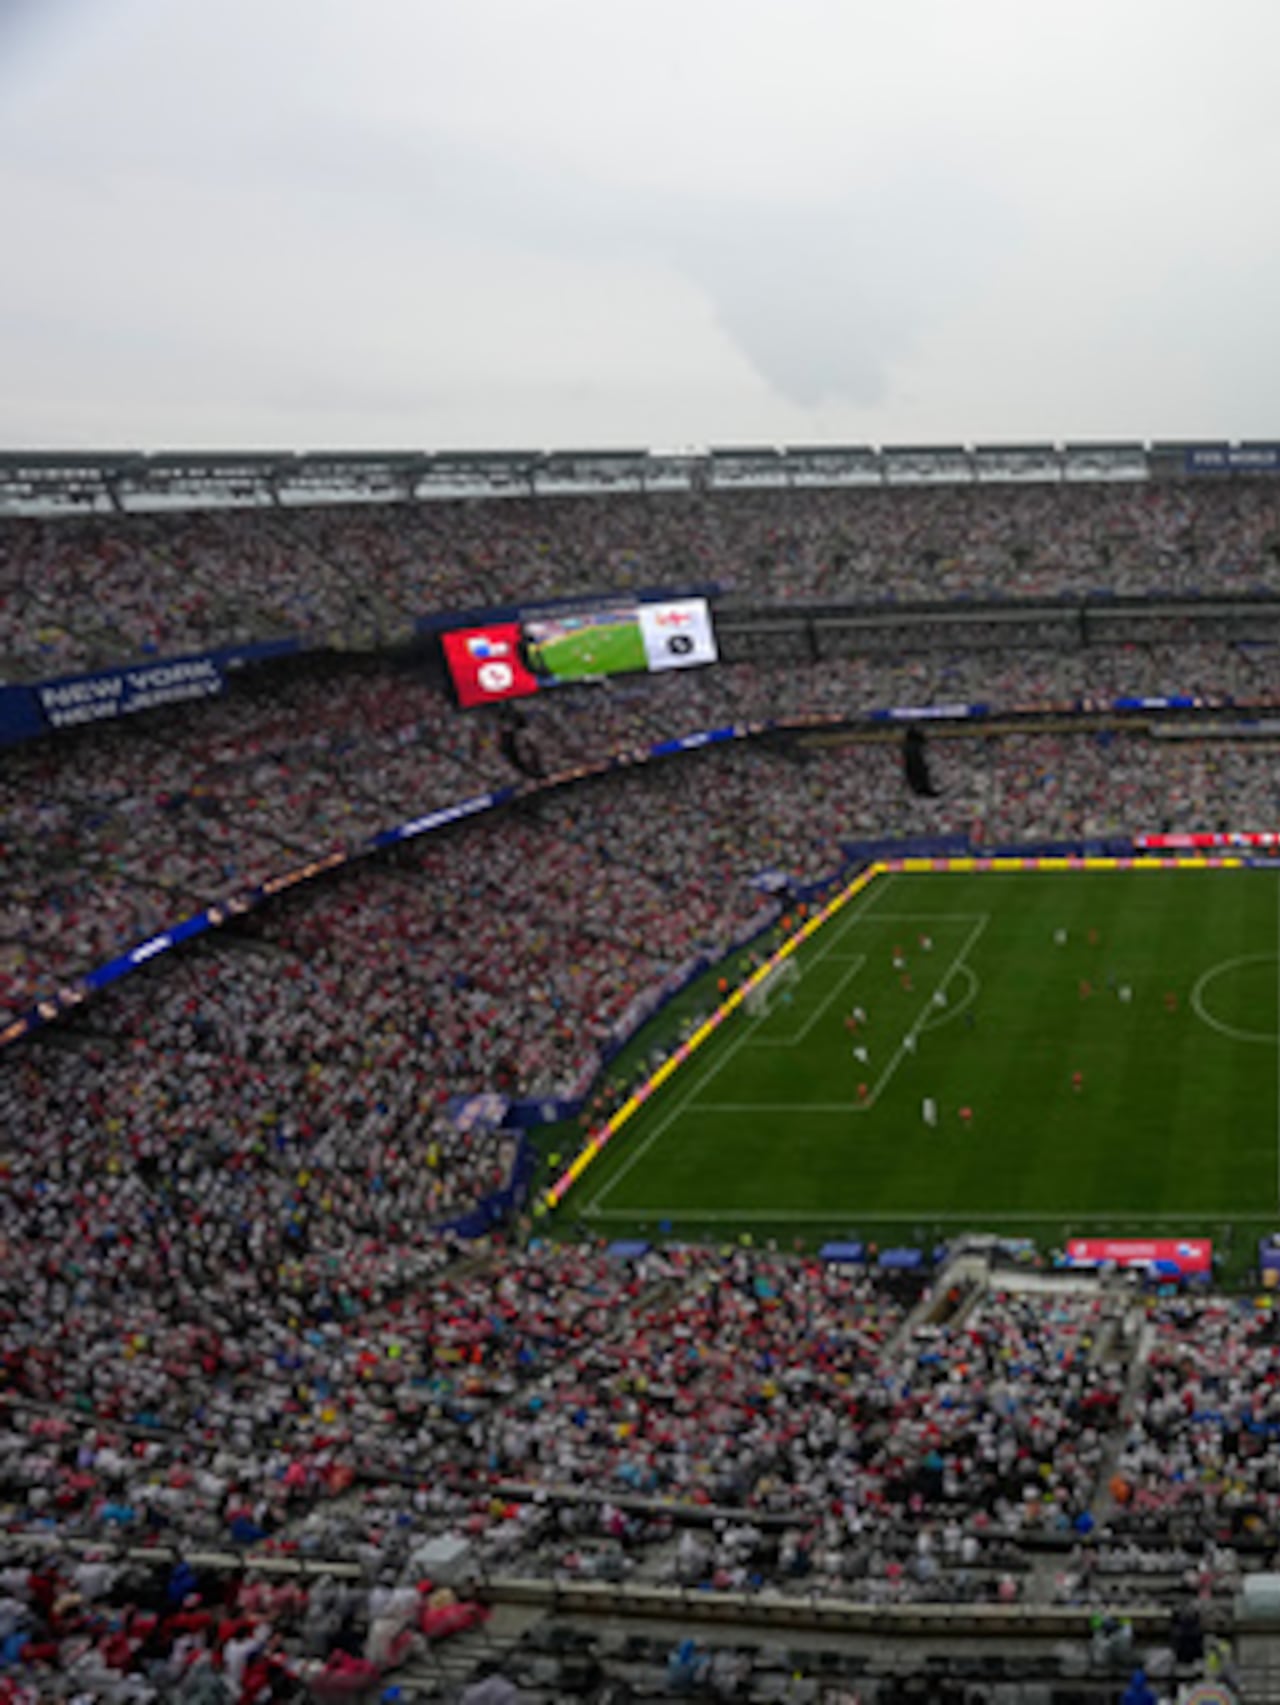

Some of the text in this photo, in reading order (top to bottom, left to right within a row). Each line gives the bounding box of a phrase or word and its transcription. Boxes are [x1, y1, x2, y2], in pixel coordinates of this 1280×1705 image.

[42, 660, 217, 708] NEW YORK
[50, 678, 222, 728] NEW JERSEY
